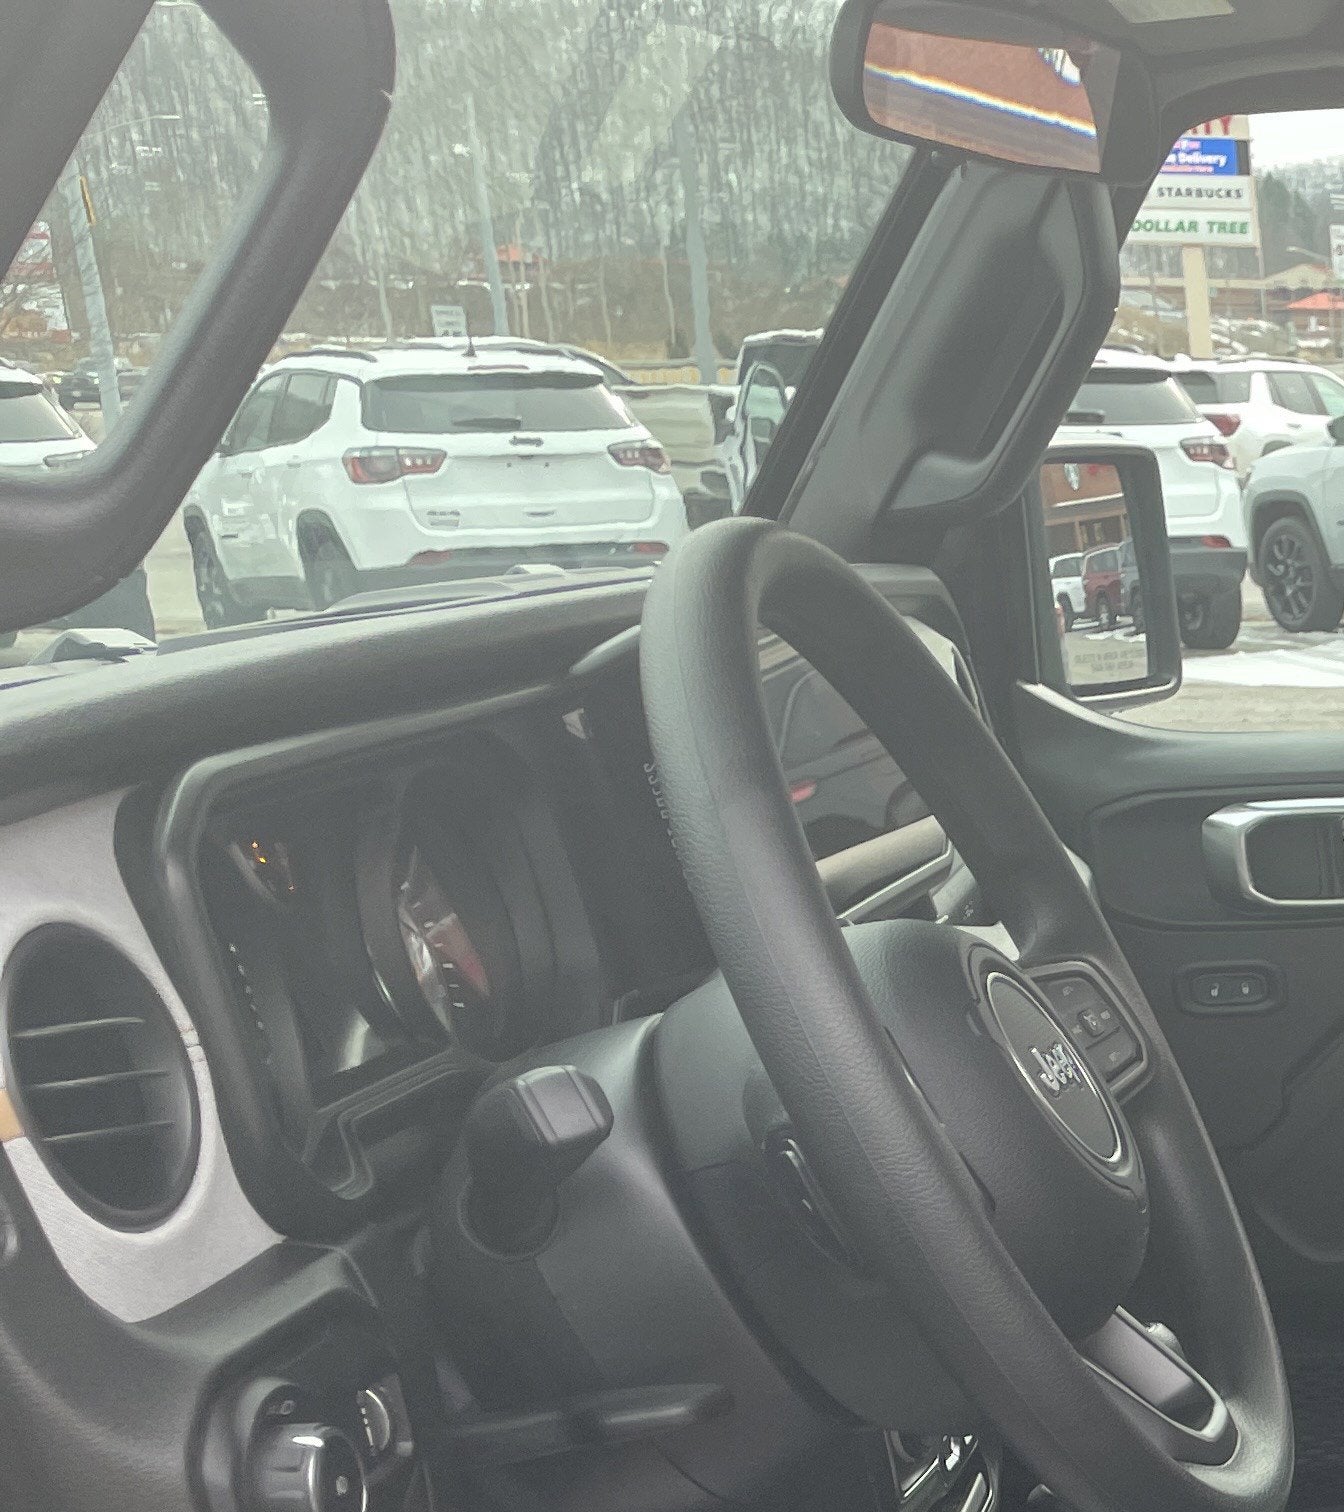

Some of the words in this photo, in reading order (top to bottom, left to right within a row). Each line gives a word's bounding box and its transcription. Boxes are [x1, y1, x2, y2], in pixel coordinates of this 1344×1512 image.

[1157, 186, 1243, 200] STARBUCKS
[1131, 219, 1198, 234] DOLLAR
[1207, 220, 1249, 235] TREE
[1030, 1043, 1082, 1091] Jeep
